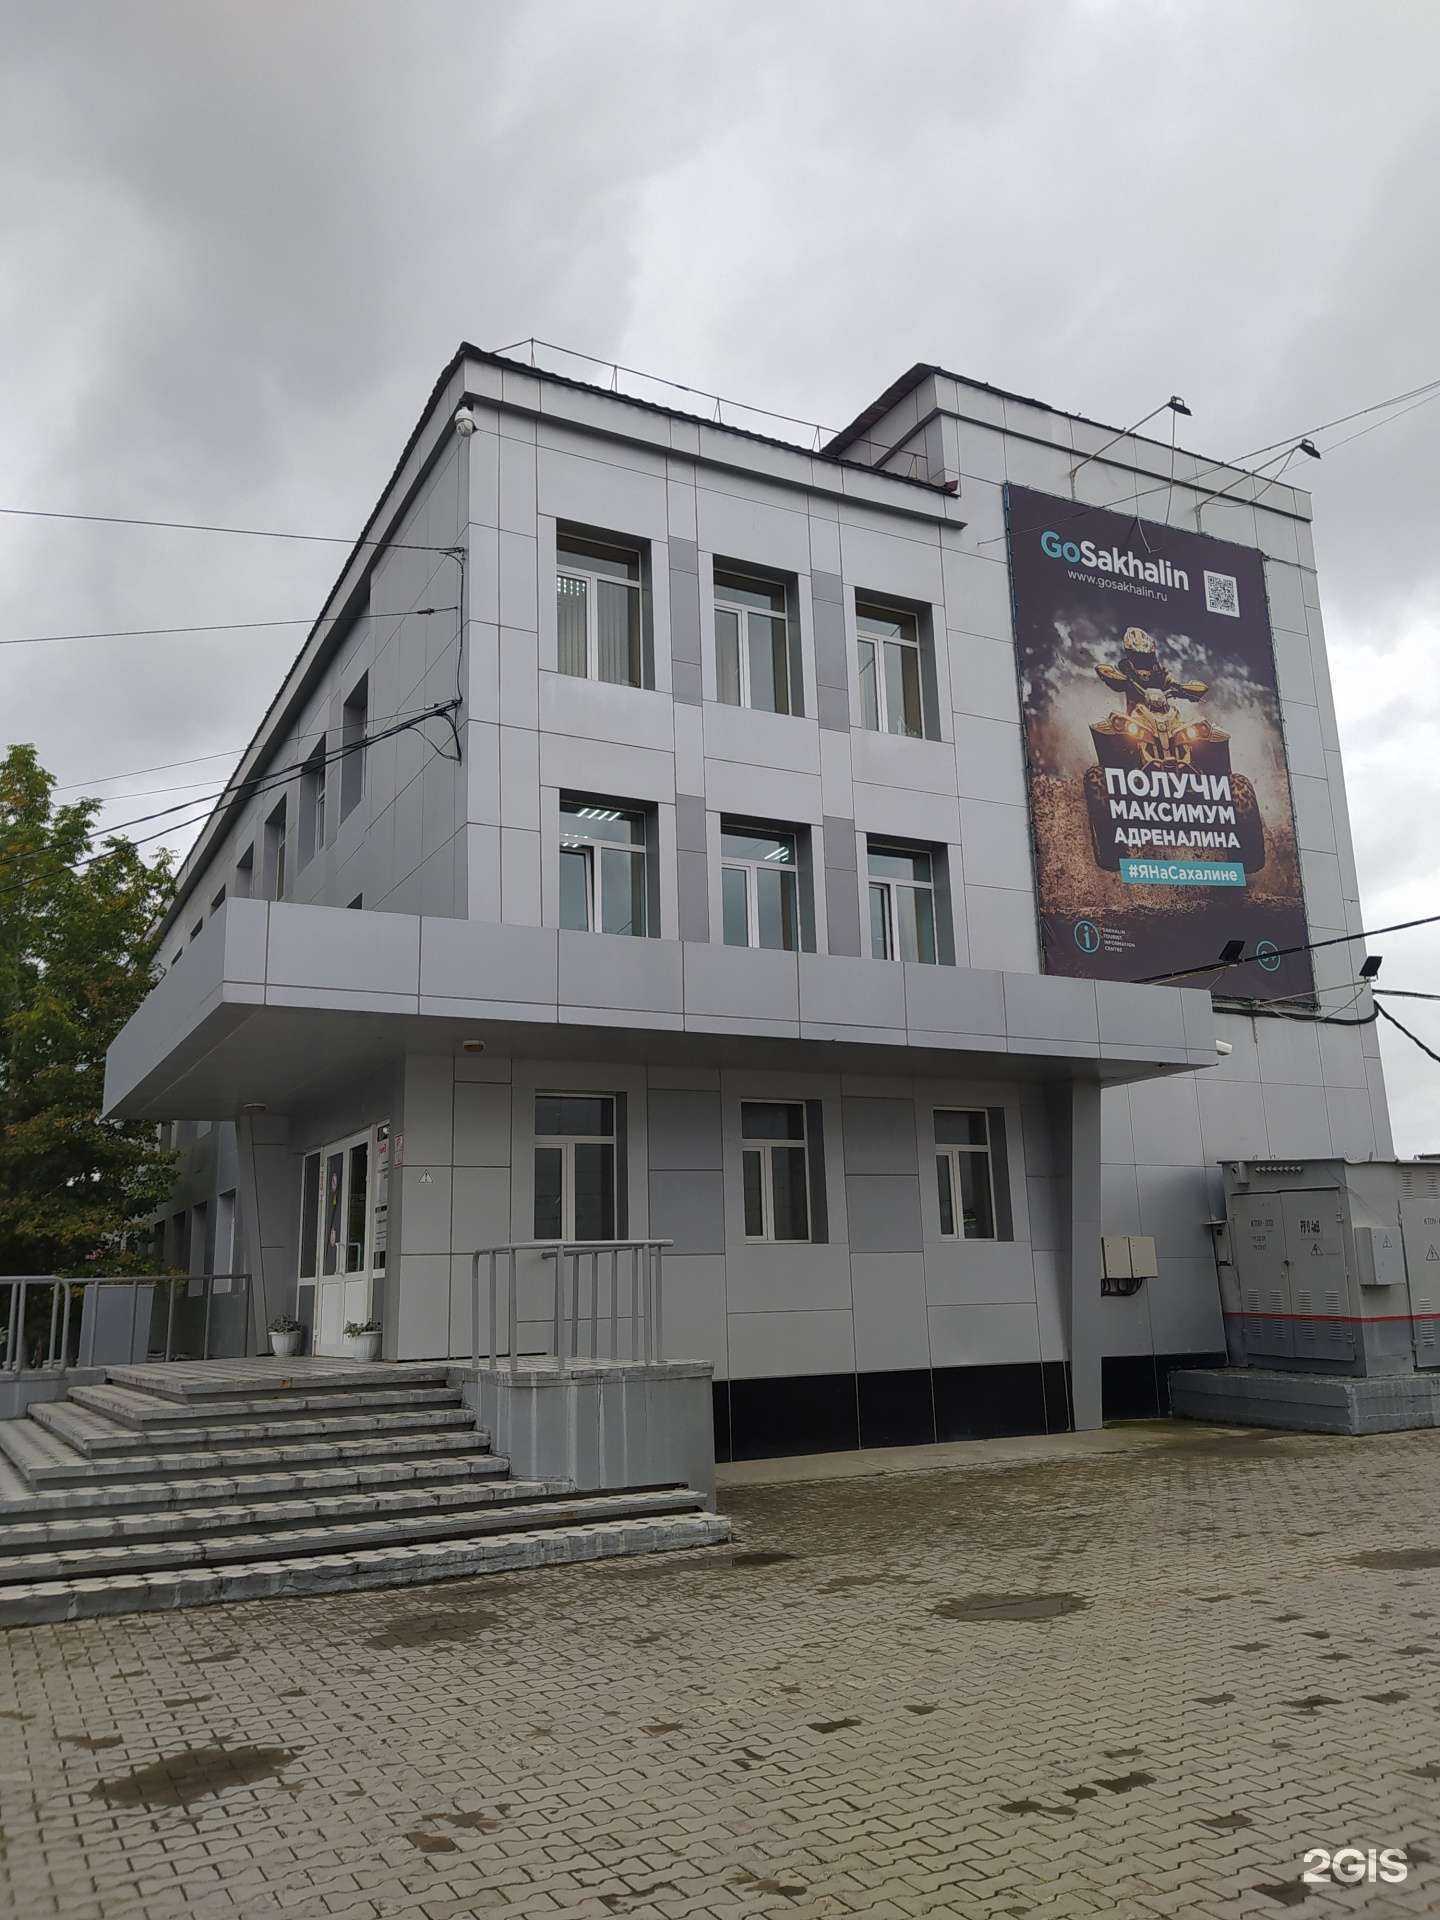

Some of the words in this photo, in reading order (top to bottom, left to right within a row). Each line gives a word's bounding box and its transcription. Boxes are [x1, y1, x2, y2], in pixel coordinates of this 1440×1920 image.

[1040, 531, 1190, 591] GoSakhalin
[1067, 569, 1168, 602] www.gosakhalin.ru
[1105, 768, 1232, 801] ПОЛУЧИ
[1109, 800, 1236, 824] МАКСИМУМ
[1114, 827, 1241, 849] АДРЕНАЛИНА
[1128, 863, 1238, 882] #ЯНаСахалине
